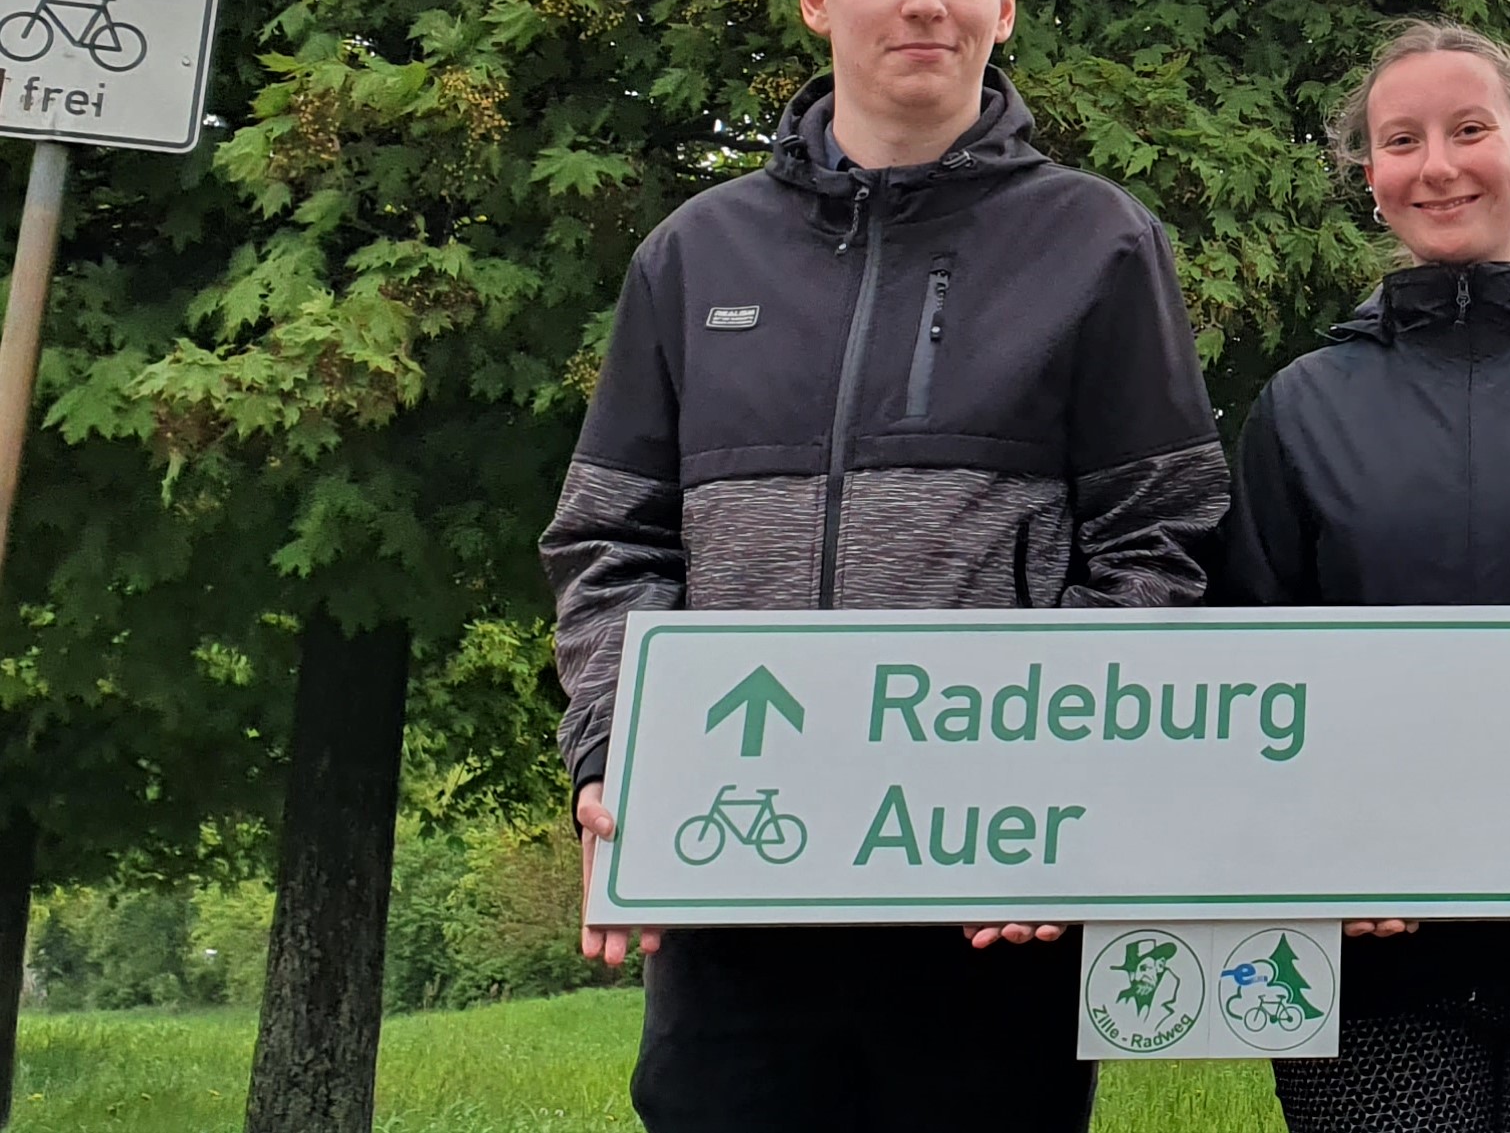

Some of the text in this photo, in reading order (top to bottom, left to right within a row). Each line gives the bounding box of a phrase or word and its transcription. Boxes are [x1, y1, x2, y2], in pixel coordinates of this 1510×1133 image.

[22, 77, 105, 117] frei
[869, 663, 1306, 761] Radeburg
[853, 785, 1086, 865] Auer
